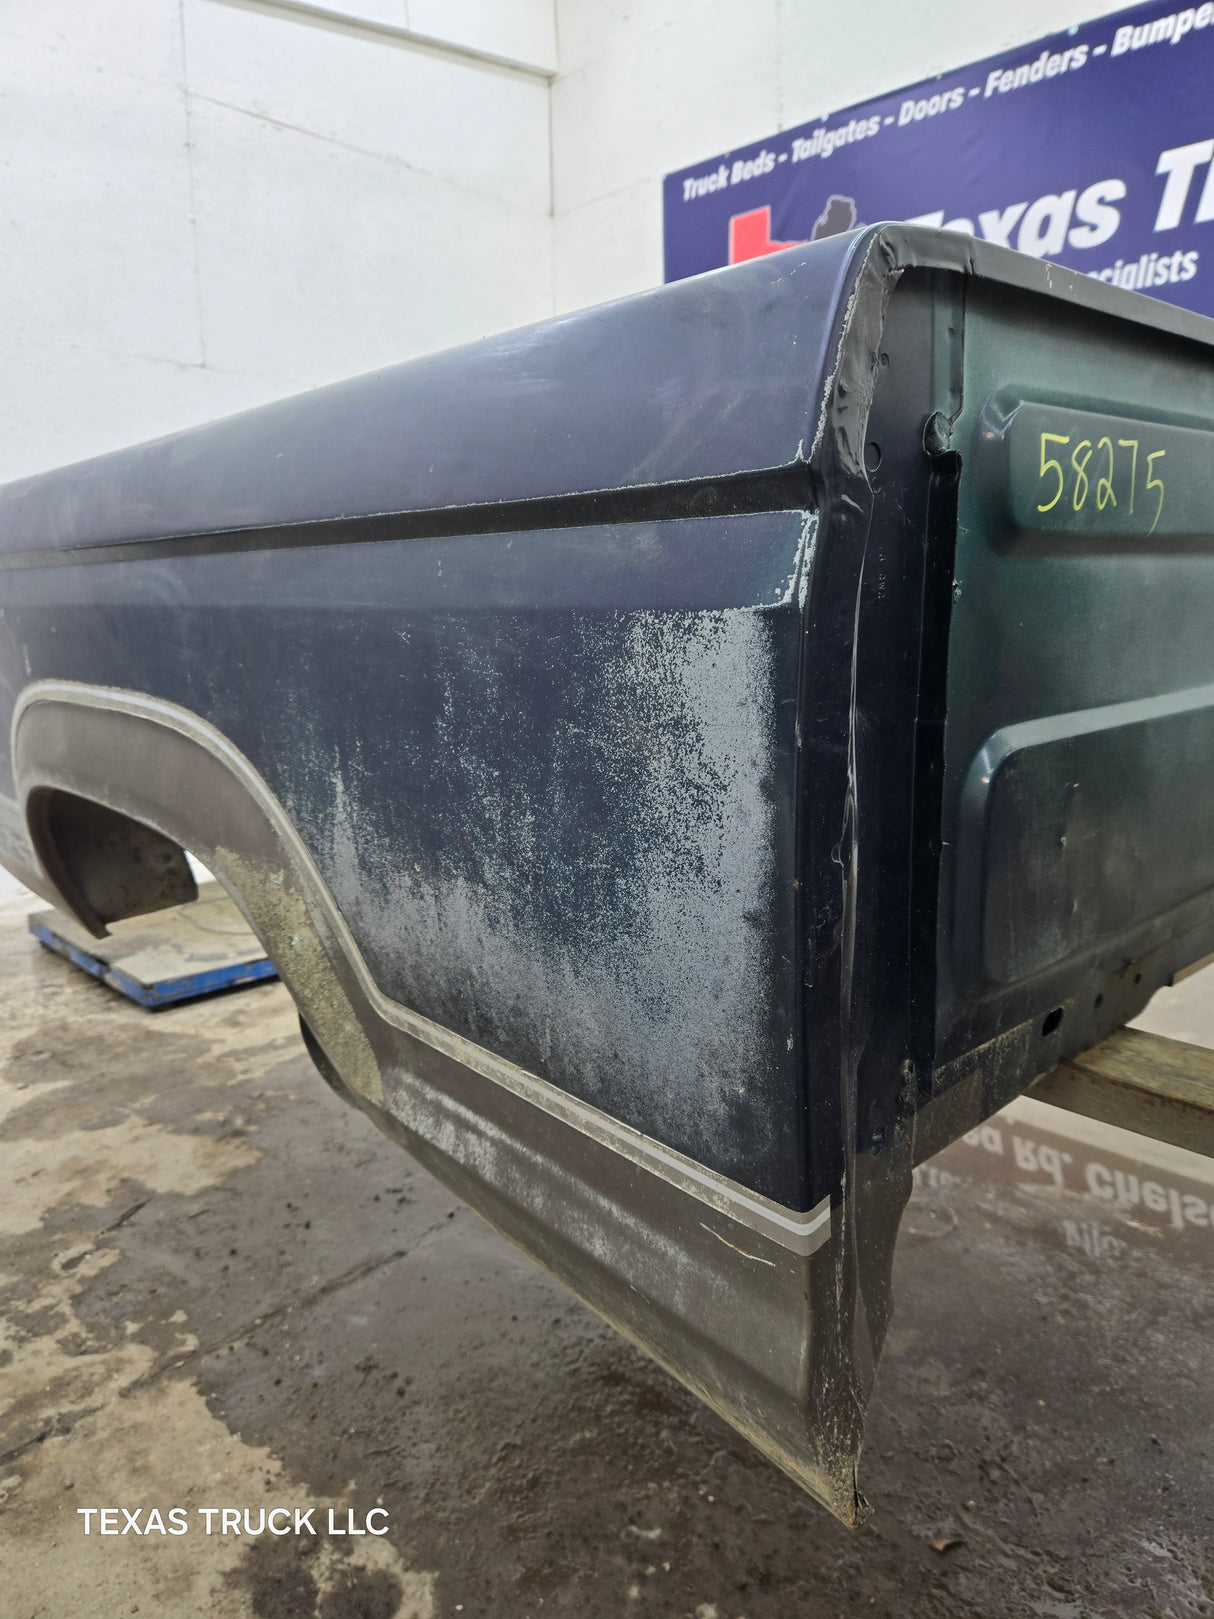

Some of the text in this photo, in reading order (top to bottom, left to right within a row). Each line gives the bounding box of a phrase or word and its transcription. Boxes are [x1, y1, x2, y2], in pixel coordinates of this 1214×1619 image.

[683, 163, 731, 201] Truck
[730, 149, 776, 185] Beds
[791, 115, 881, 164] Tailgates
[898, 85, 965, 128] Doors
[983, 44, 1090, 99] Fenders
[1110, 1, 1214, 58] Bumpe
[903, 138, 1214, 258] xas T
[1037, 432, 1166, 537] 58275
